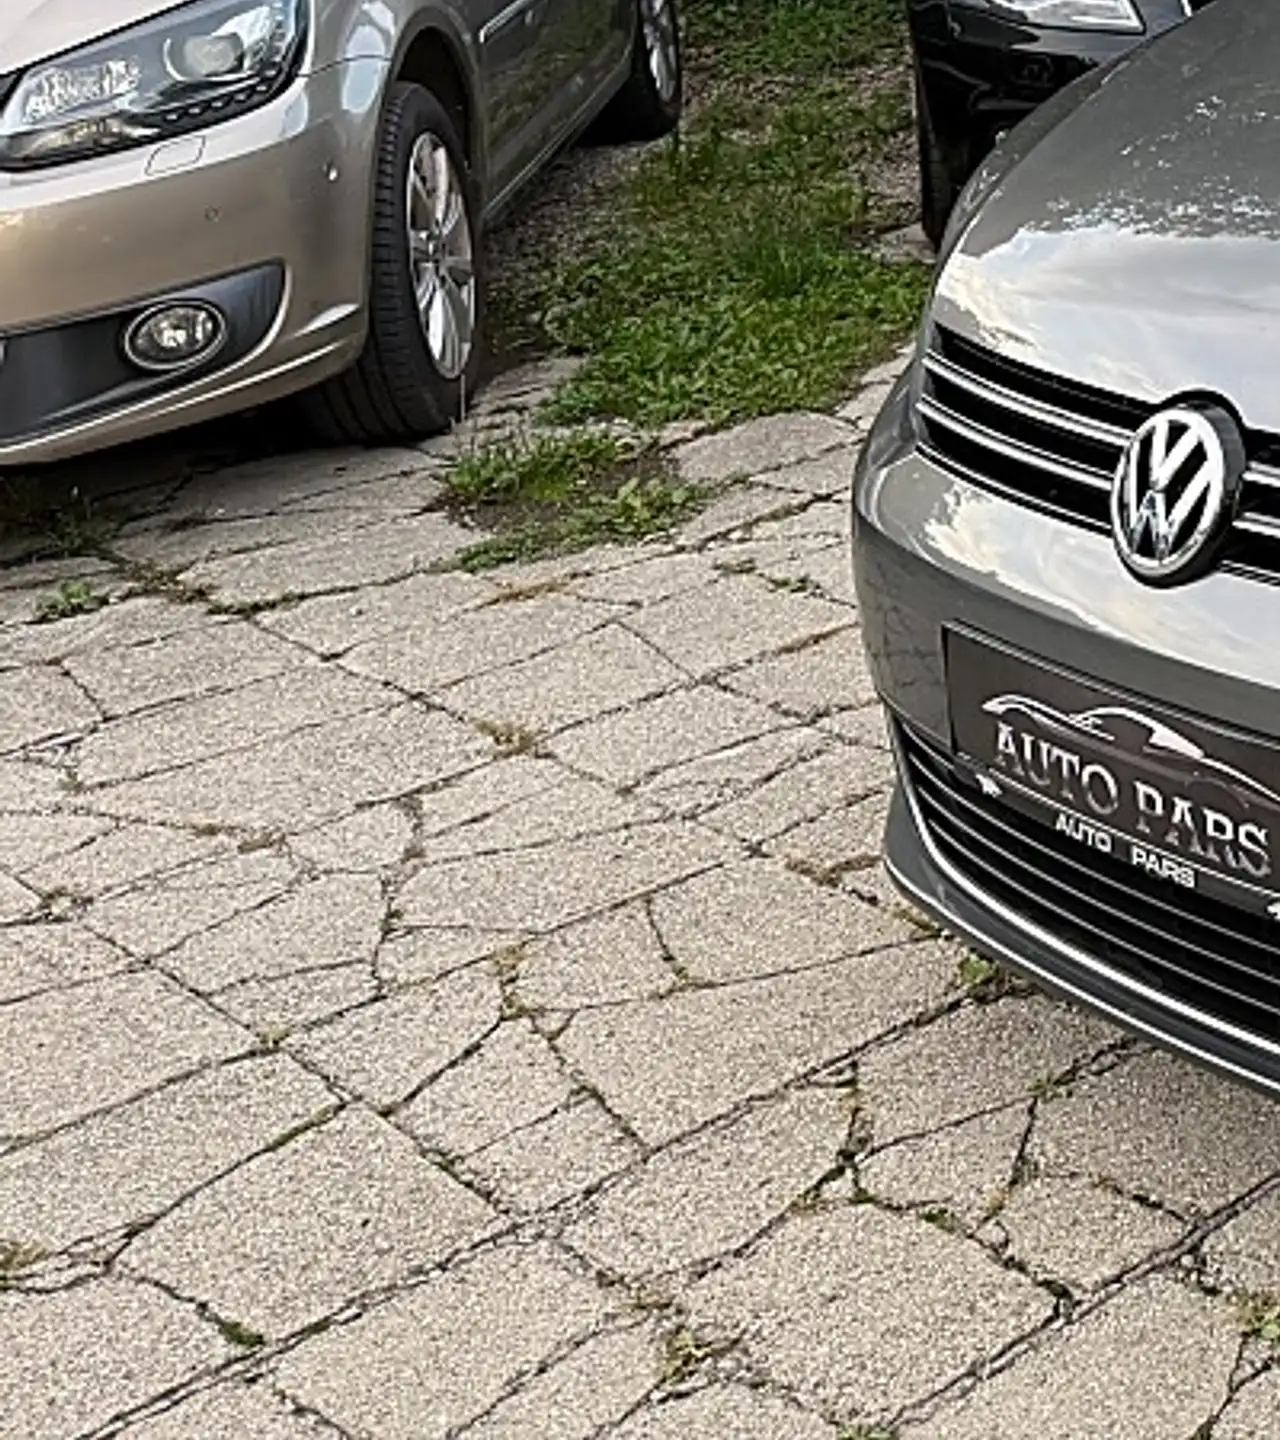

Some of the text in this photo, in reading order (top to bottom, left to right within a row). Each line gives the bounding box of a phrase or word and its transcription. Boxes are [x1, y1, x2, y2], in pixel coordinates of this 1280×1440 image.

[1118, 414, 1219, 566] VW
[994, 718, 1272, 878] AUTO PARS
[1055, 811, 1197, 889] AUTO PARS
